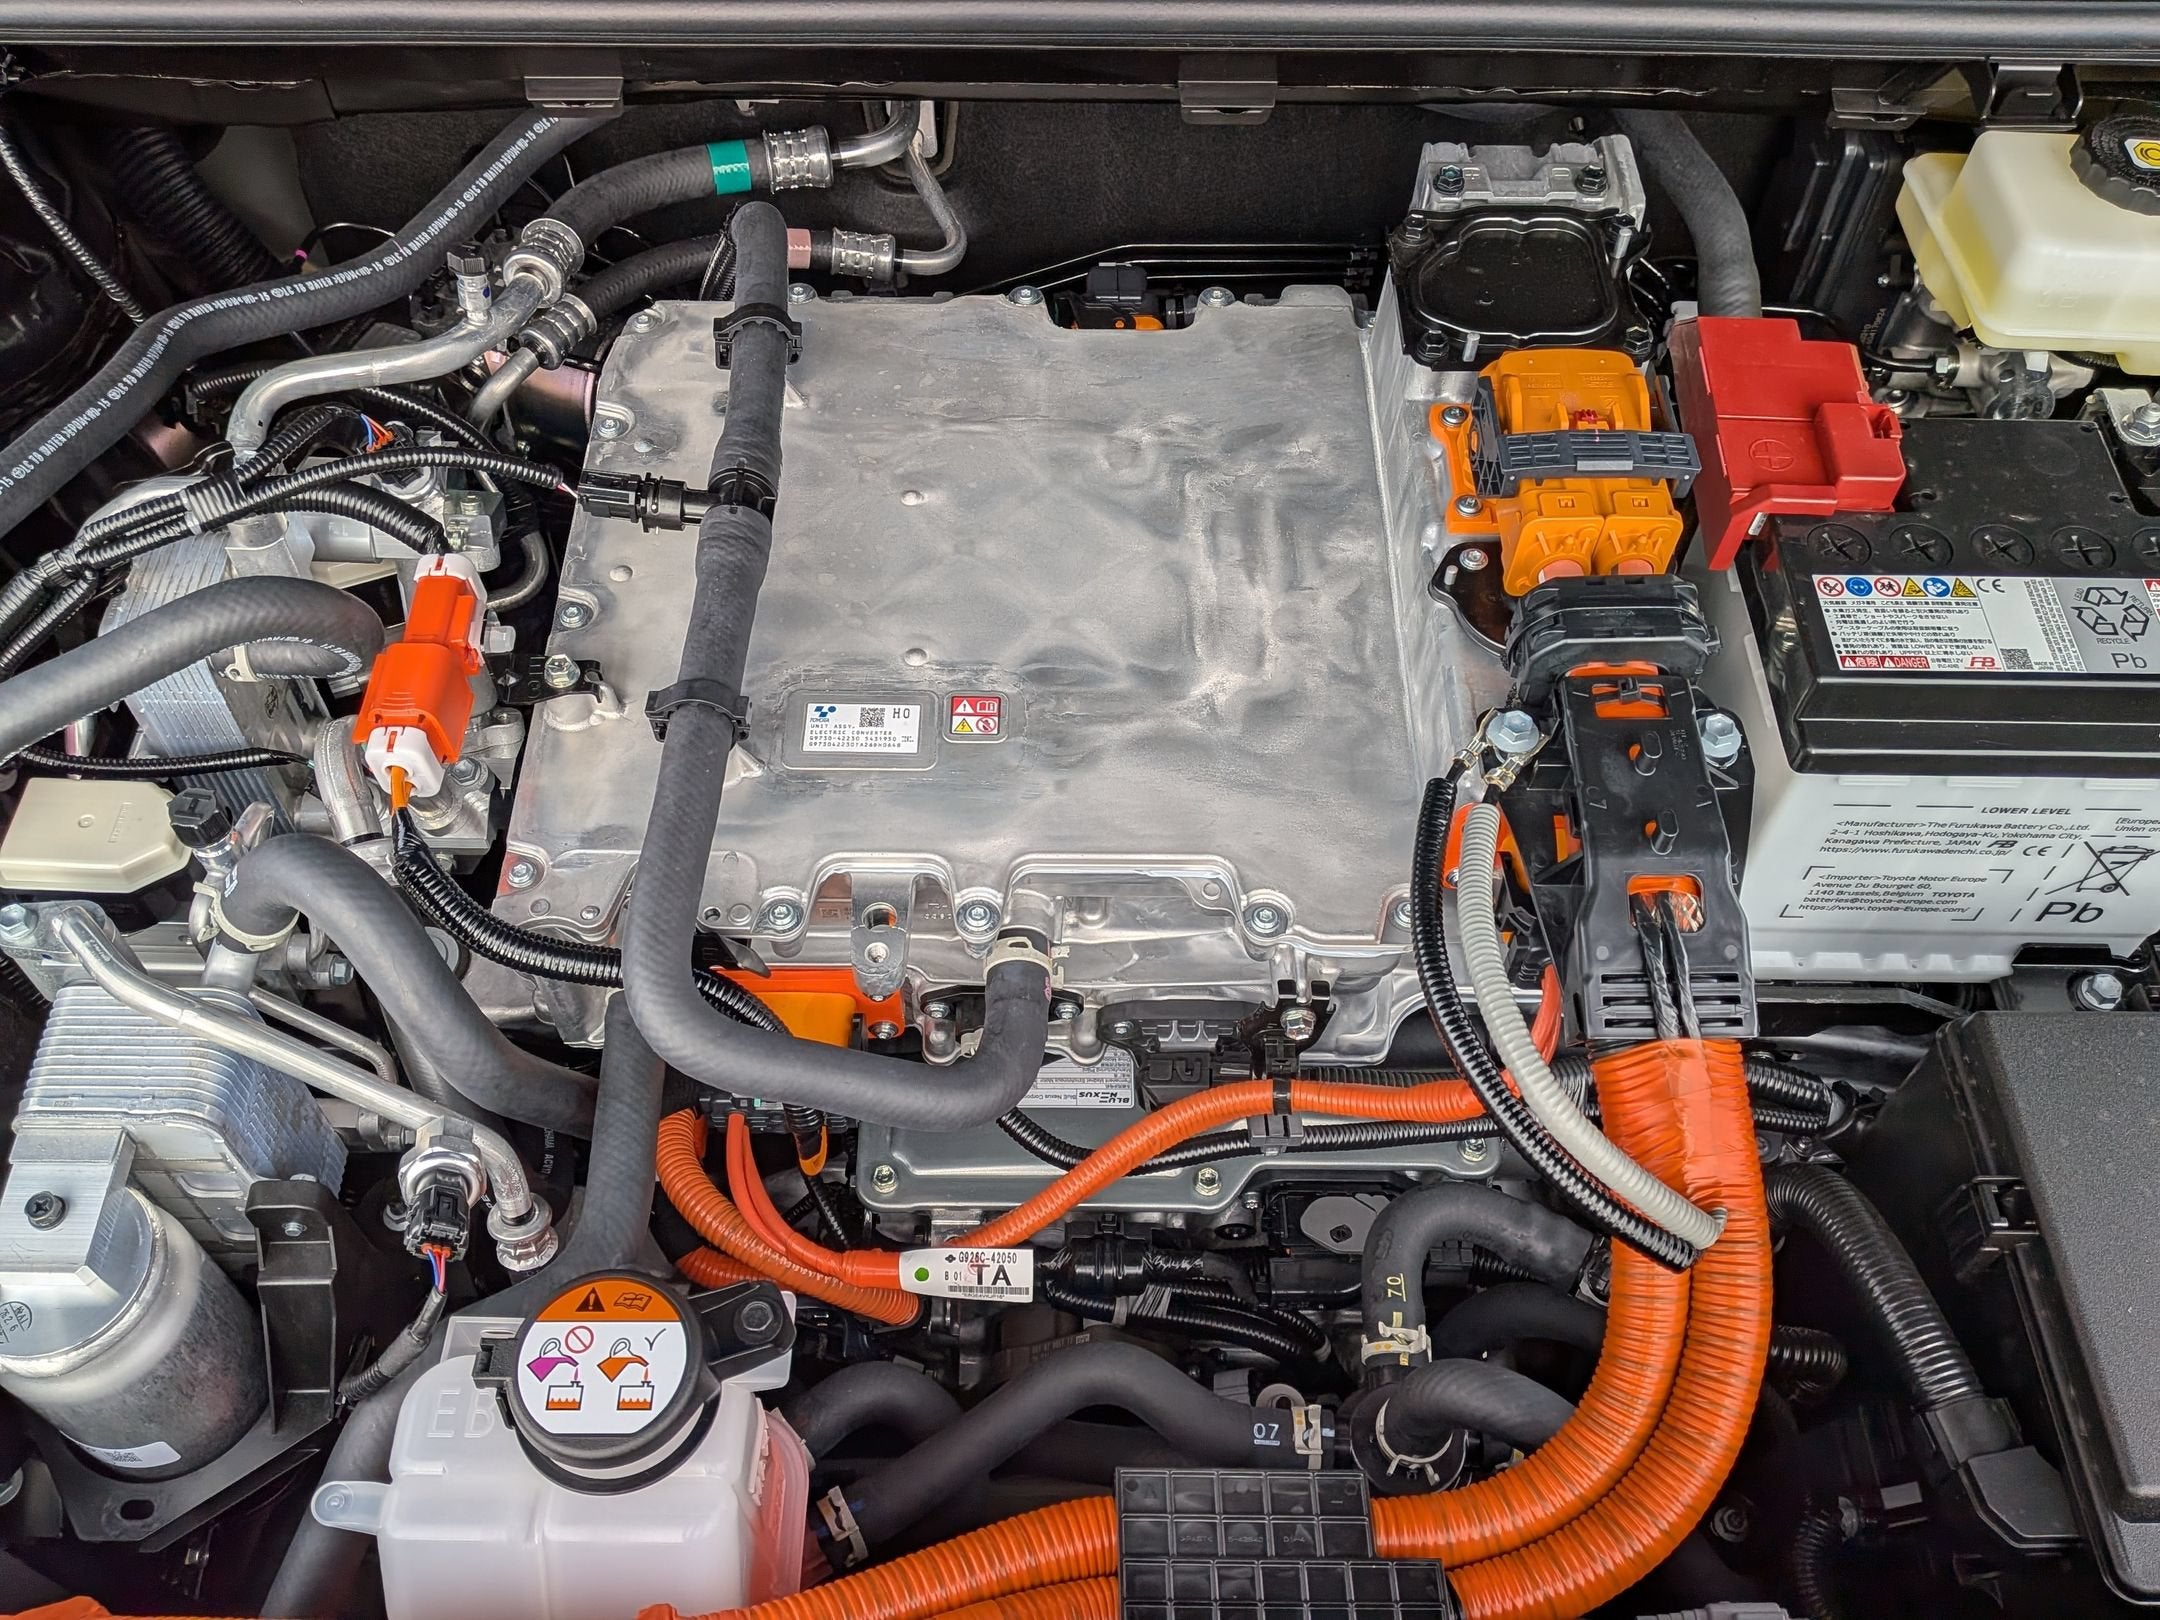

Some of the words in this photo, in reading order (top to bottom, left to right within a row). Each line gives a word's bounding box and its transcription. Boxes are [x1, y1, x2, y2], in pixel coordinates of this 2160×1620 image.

[2129, 594, 2155, 617] RETURN
[1855, 656, 1880, 668] 危険
[1893, 657, 1929, 669] DANGER
[2111, 653, 2147, 669] Pb
[1948, 821, 2002, 829] Furukawa
[2003, 823, 2046, 831] Battery
[1824, 838, 1881, 846] Kanagawa
[1882, 838, 1941, 847] Prefecture,
[2034, 901, 2104, 924] Pb
[958, 1251, 1017, 1264] G926C-42050
[970, 1264, 1012, 1286] TA
[1386, 1276, 1403, 1298] 70
[1253, 1422, 1280, 1440] 07
